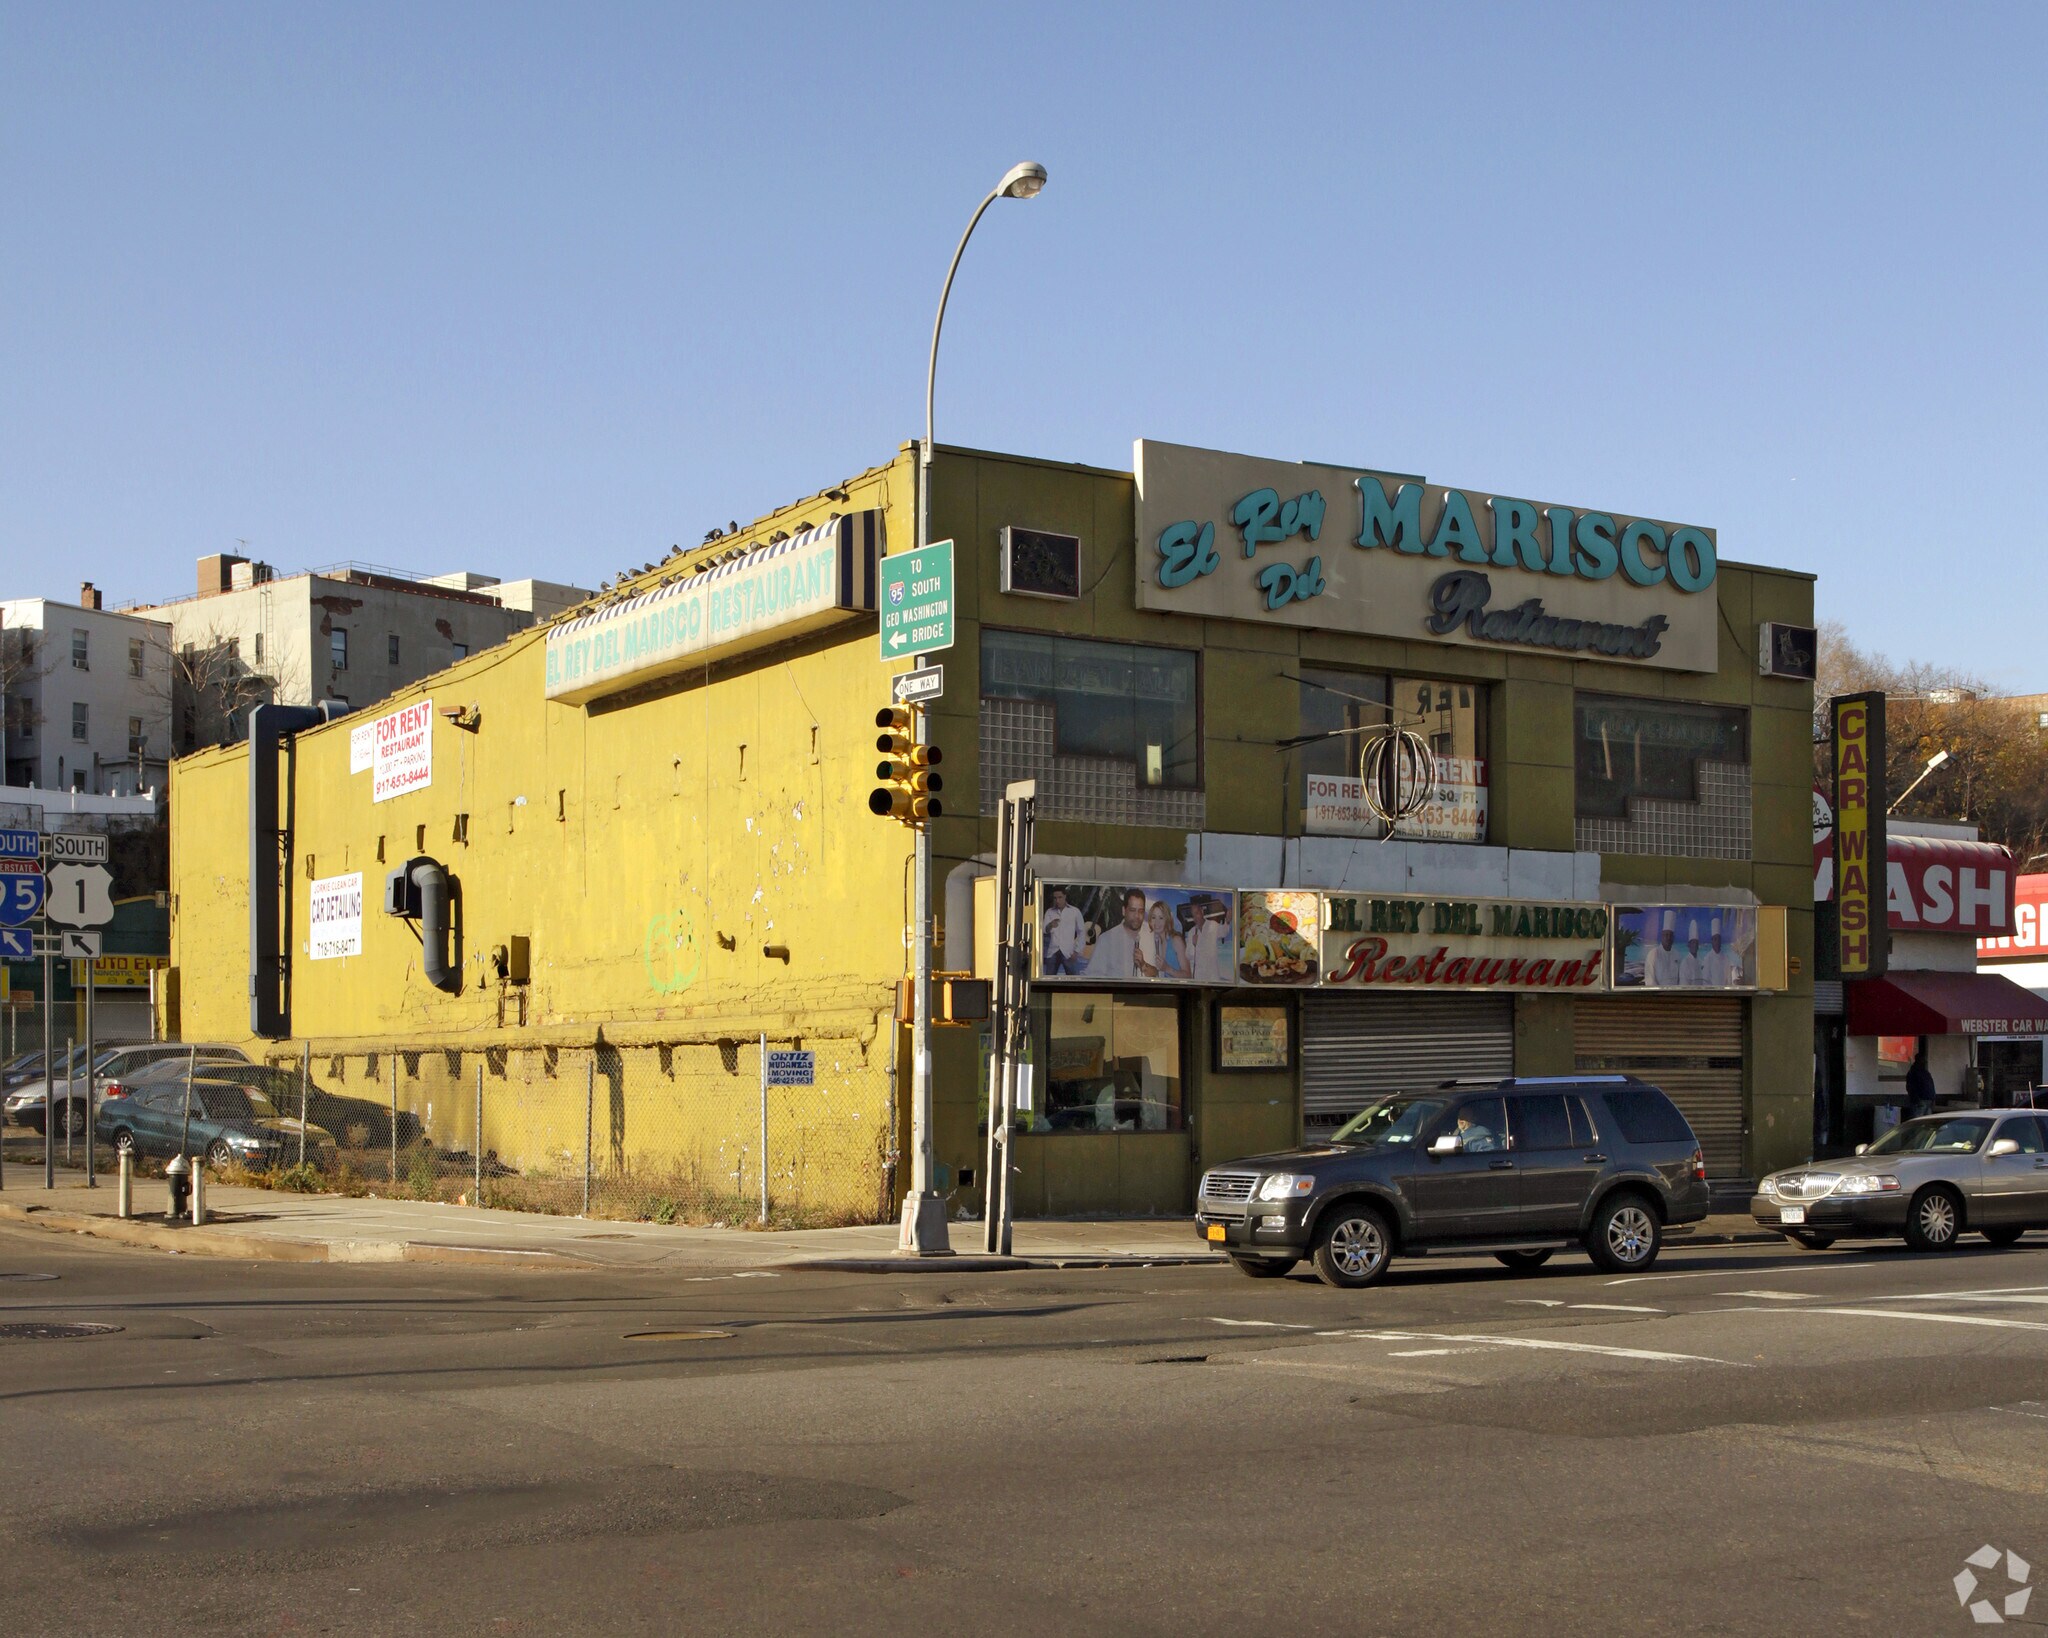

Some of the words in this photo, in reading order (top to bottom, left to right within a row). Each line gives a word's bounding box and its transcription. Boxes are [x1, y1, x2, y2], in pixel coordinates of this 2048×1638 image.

[1158, 520, 1221, 588] El
[1231, 487, 1327, 559] Rey
[1354, 476, 1717, 594] MARISCO
[911, 558, 922, 575] TO
[891, 588, 903, 601] 95
[911, 576, 940, 597] SOUTH
[1257, 555, 1326, 610] Del
[546, 649, 560, 689] EL
[565, 639, 591, 682] REY
[593, 629, 620, 672] DEL
[623, 597, 701, 662] MARISCO
[711, 547, 835, 634] RESTAURANT
[886, 612, 900, 628] GEO
[902, 599, 948, 624] WASHINGTON
[1425, 570, 1670, 659] Restaurant
[912, 622, 944, 643] BRIDGE
[900, 681, 914, 695] ONE
[920, 676, 936, 690] WAY
[376, 717, 397, 745] FOR
[400, 703, 430, 736] RENT
[381, 731, 425, 759] RESTAURANT
[1435, 757, 1485, 784] RENT
[1839, 708, 1866, 811] CAR
[376, 765, 429, 795] 917-653-8444
[1309, 781, 1337, 797] FOR
[1439, 788, 1458, 803] SQ.
[1462, 790, 1479, 804] FT.
[1315, 805, 1371, 822] 1-917-653-8444
[54, 836, 105, 857] SOUTH
[75, 879, 85, 914] 1
[312, 897, 325, 924] CAR
[326, 891, 361, 922] DETAILING
[1840, 829, 1867, 966] WASH
[1325, 898, 1362, 932] EL
[1369, 900, 1425, 933] REY
[1431, 902, 1483, 936] DEL
[1492, 904, 1608, 939] MARISCO
[84, 957, 128, 970] UTO
[134, 957, 170, 970] ELE
[1328, 936, 1604, 987] Restaurant
[1961, 1019, 2008, 1033] WEBSTER
[2012, 1019, 2033, 1033] CAR
[768, 1061, 813, 1069] MUDANZAS
[771, 1052, 809, 1061] ORTIZ
